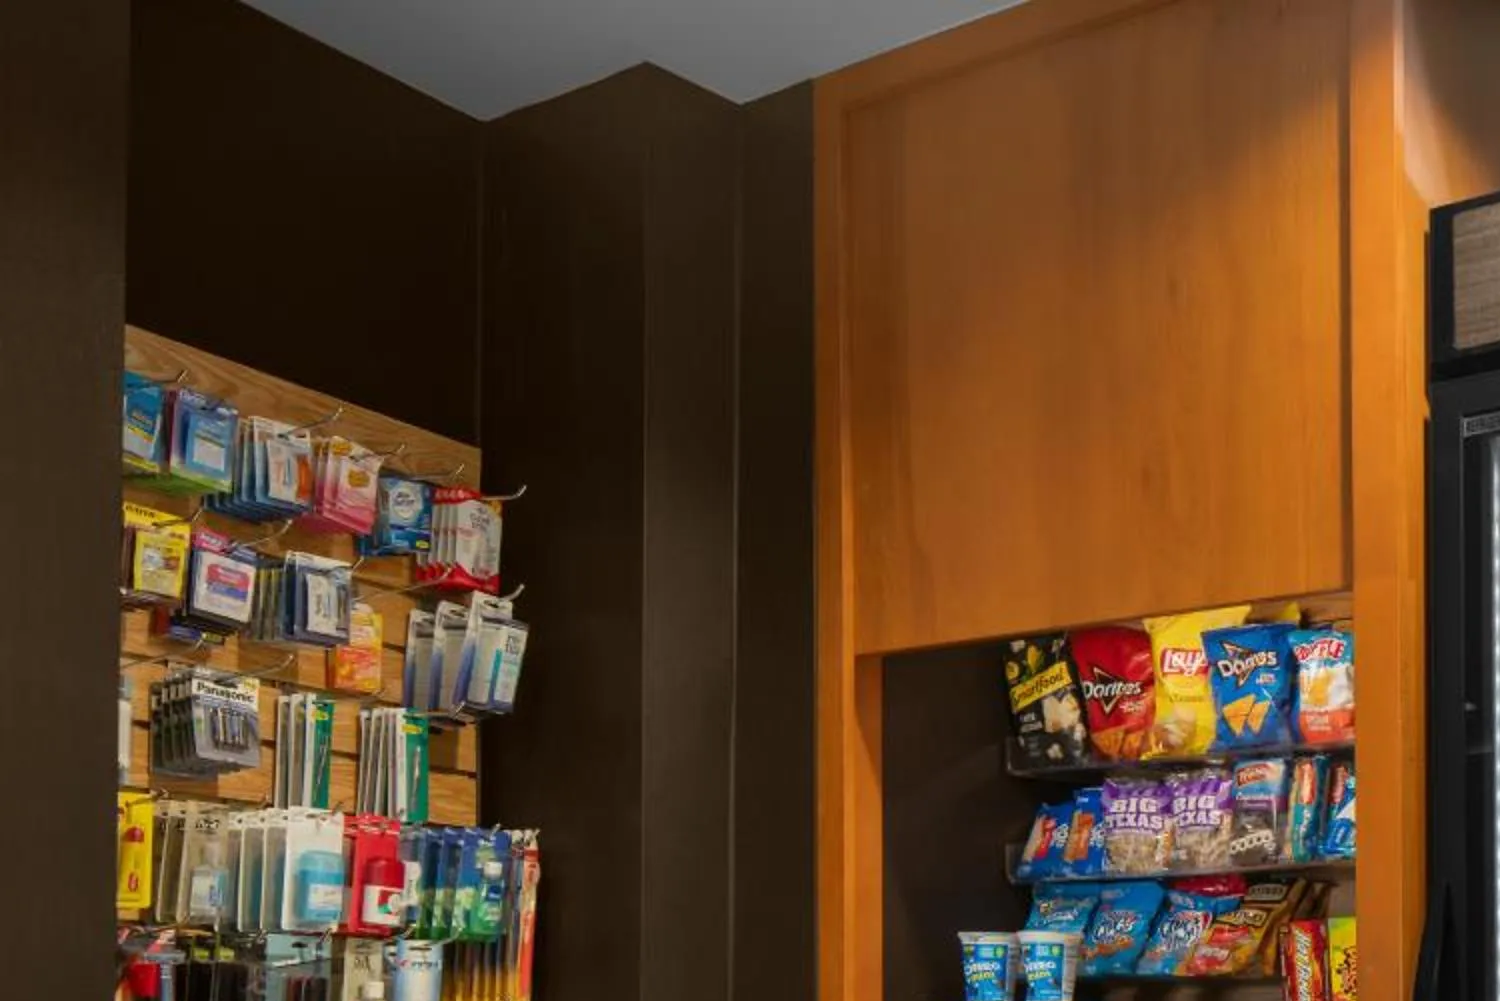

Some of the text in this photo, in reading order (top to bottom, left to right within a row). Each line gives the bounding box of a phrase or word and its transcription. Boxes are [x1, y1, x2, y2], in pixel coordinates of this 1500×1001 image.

[196, 680, 255, 702] Panasonic
[1082, 678, 1144, 699] Doritos
[1112, 797, 1158, 813] BIG
[1173, 795, 1217, 812] BIG
[1104, 813, 1164, 829] TEXAS
